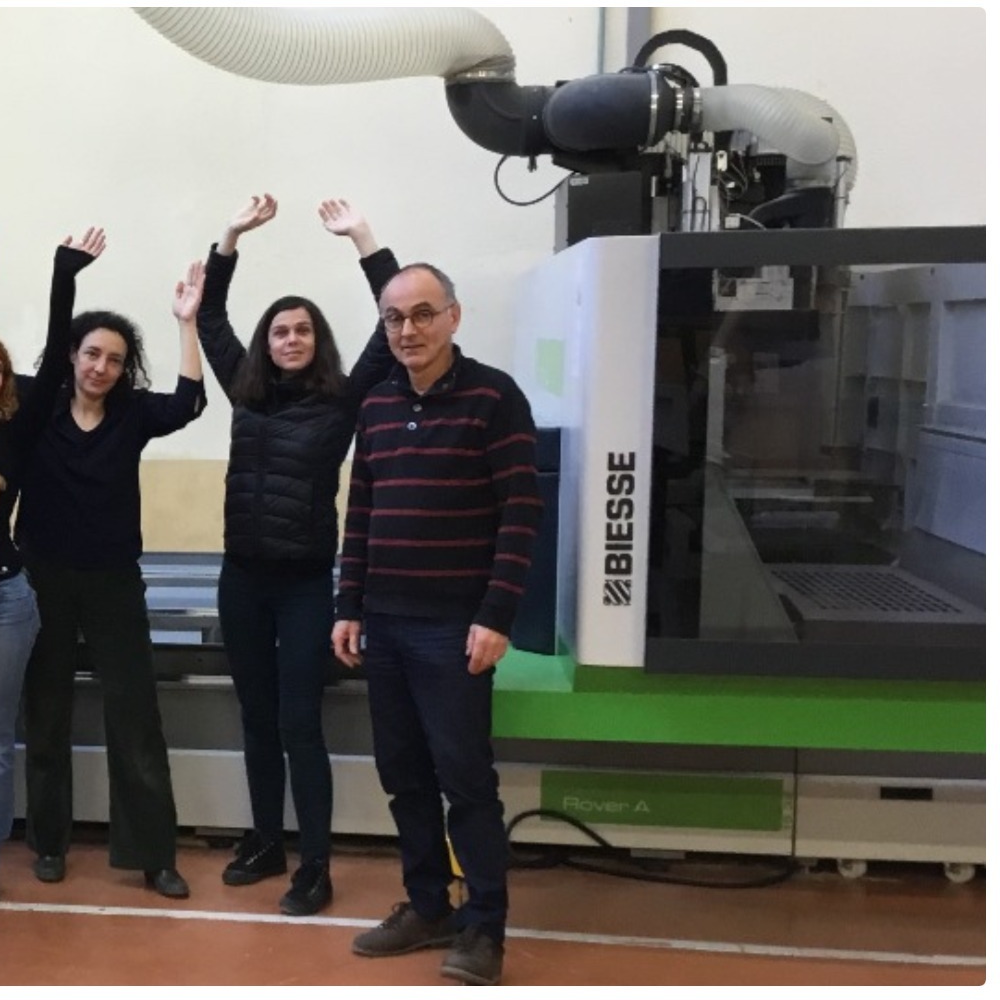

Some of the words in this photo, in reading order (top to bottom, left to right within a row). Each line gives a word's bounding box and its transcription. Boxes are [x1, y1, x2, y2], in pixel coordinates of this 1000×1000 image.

[604, 451, 635, 575] BIESSE
[562, 795, 629, 812] Rover
[634, 799, 650, 812] A
